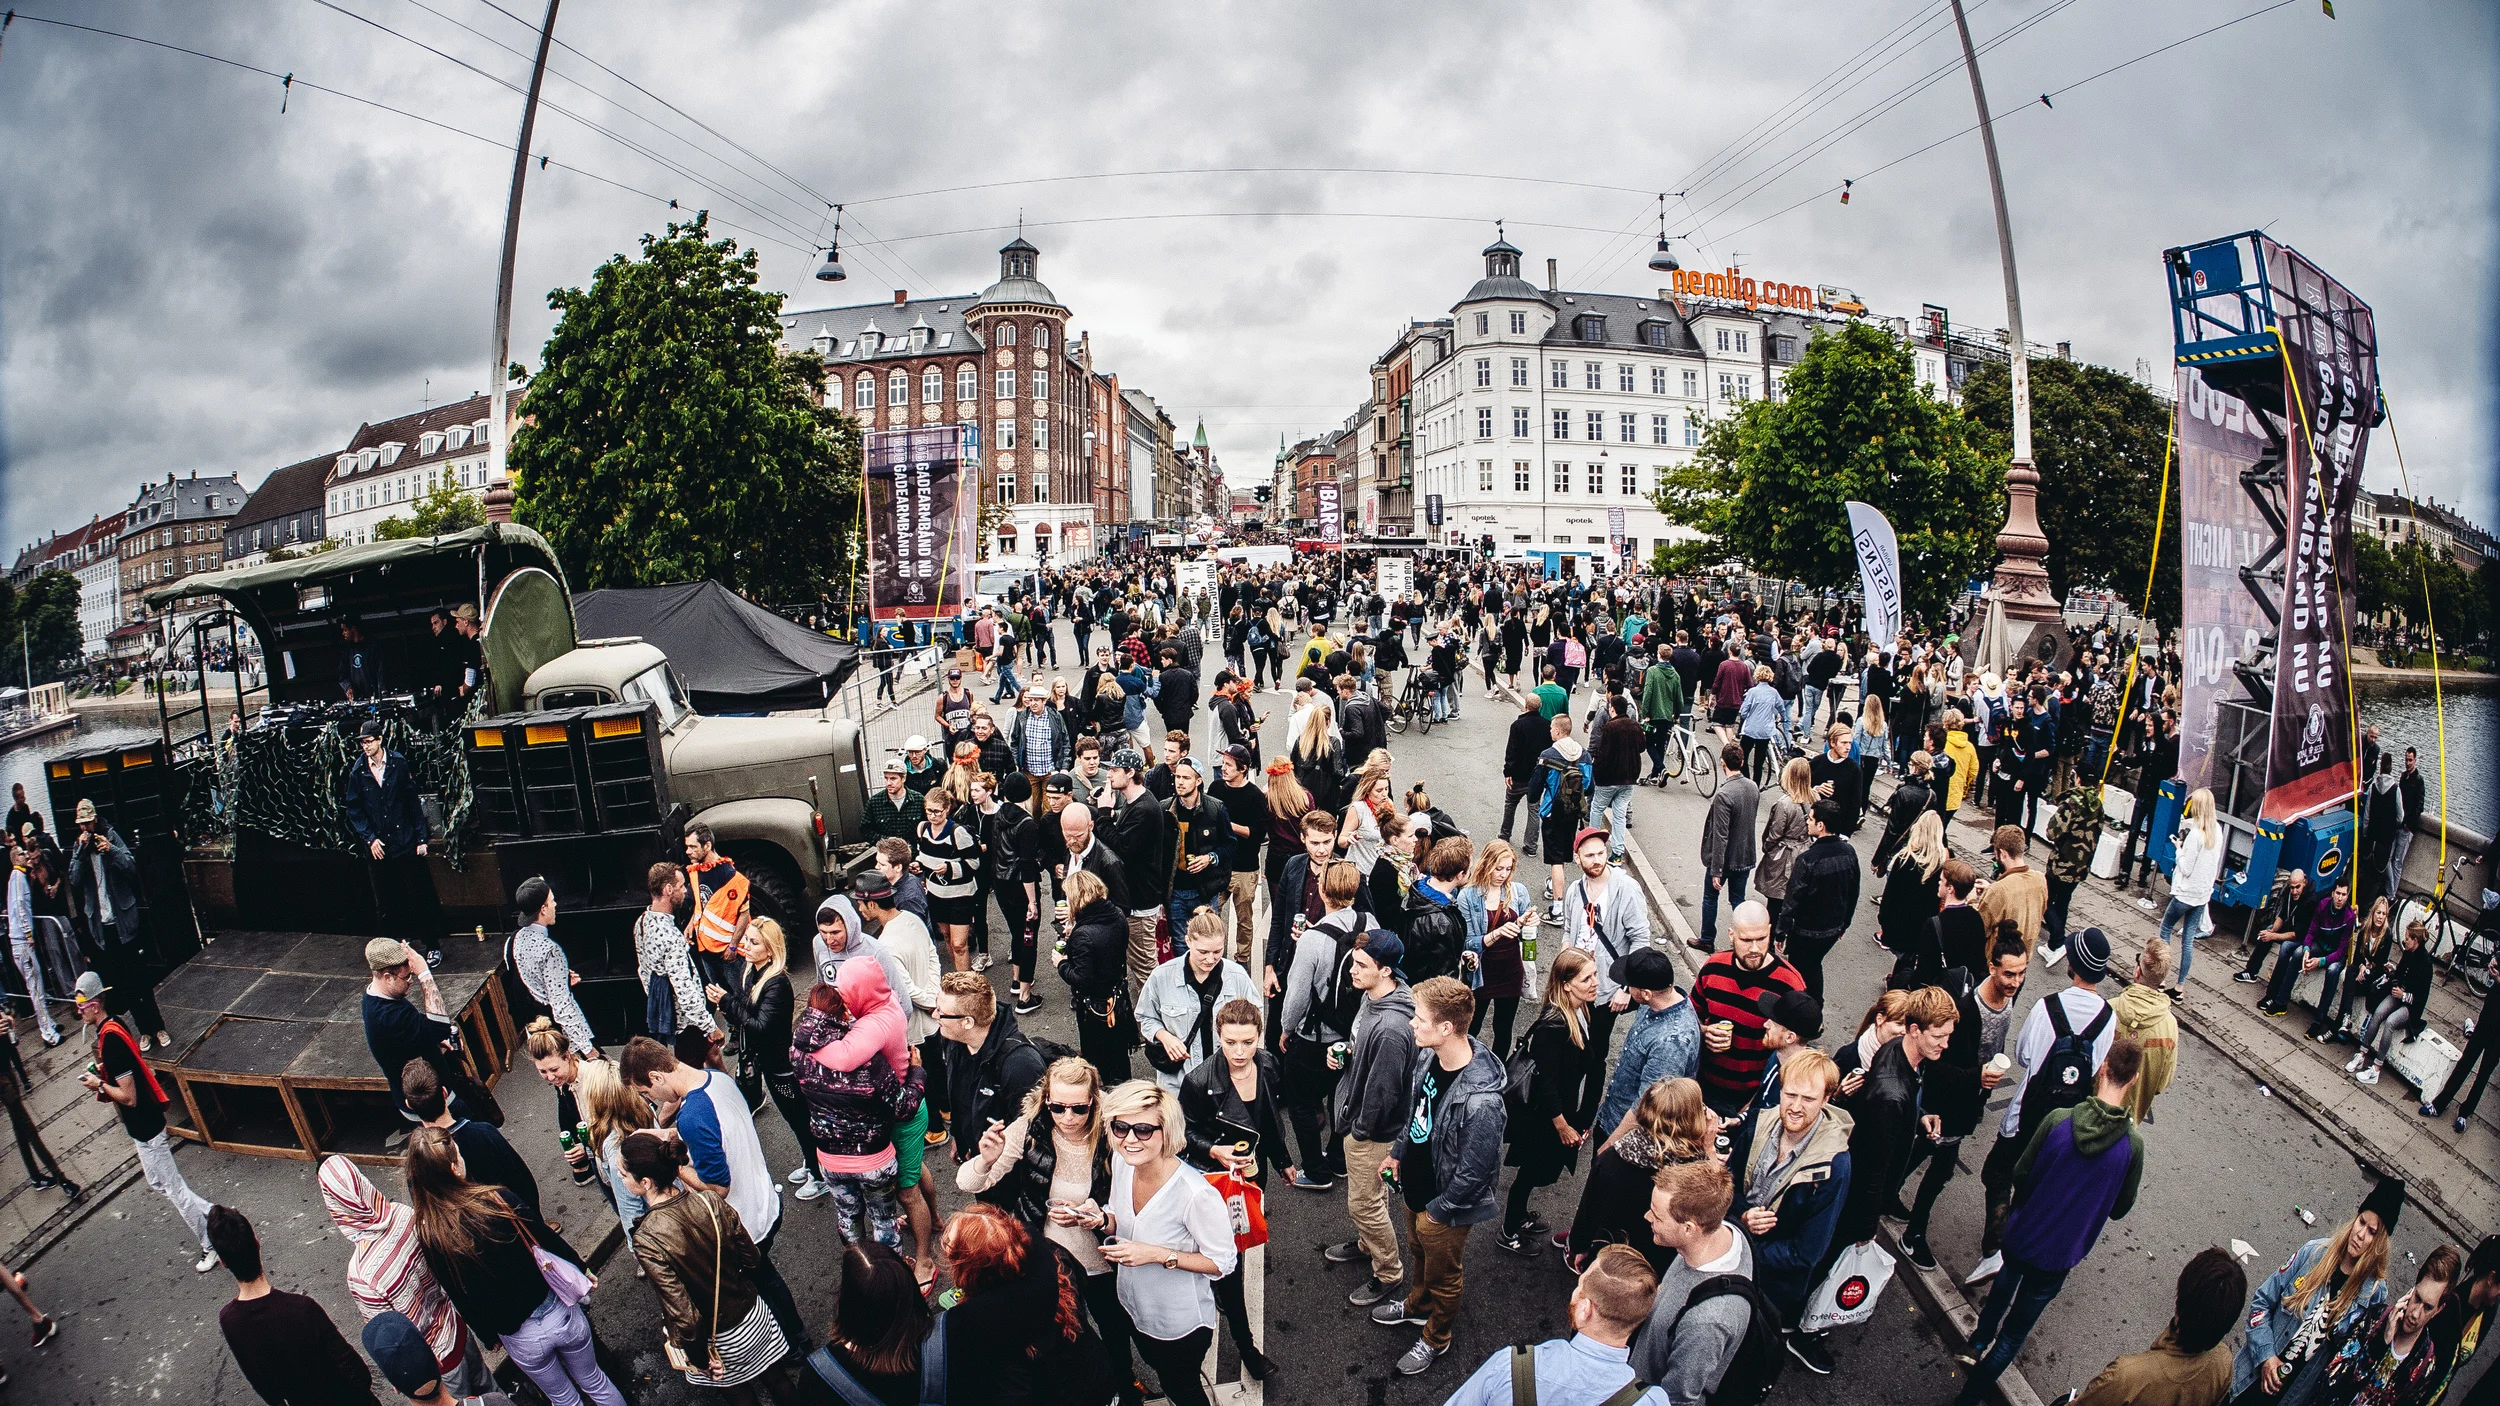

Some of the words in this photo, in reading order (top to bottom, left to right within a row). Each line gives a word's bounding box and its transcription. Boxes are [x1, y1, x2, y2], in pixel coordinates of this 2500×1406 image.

[1672, 267, 1814, 311] nemlig.com
[894, 464, 913, 556] GADEARMBÅND
[915, 462, 935, 556] GADEARMBÅND
[1319, 489, 1338, 524] BAR
[1565, 517, 1594, 525] apotek
[898, 560, 911, 578] NU
[917, 560, 932, 578] NU
[2293, 642, 2310, 693] NU
[2316, 640, 2332, 688] NU
